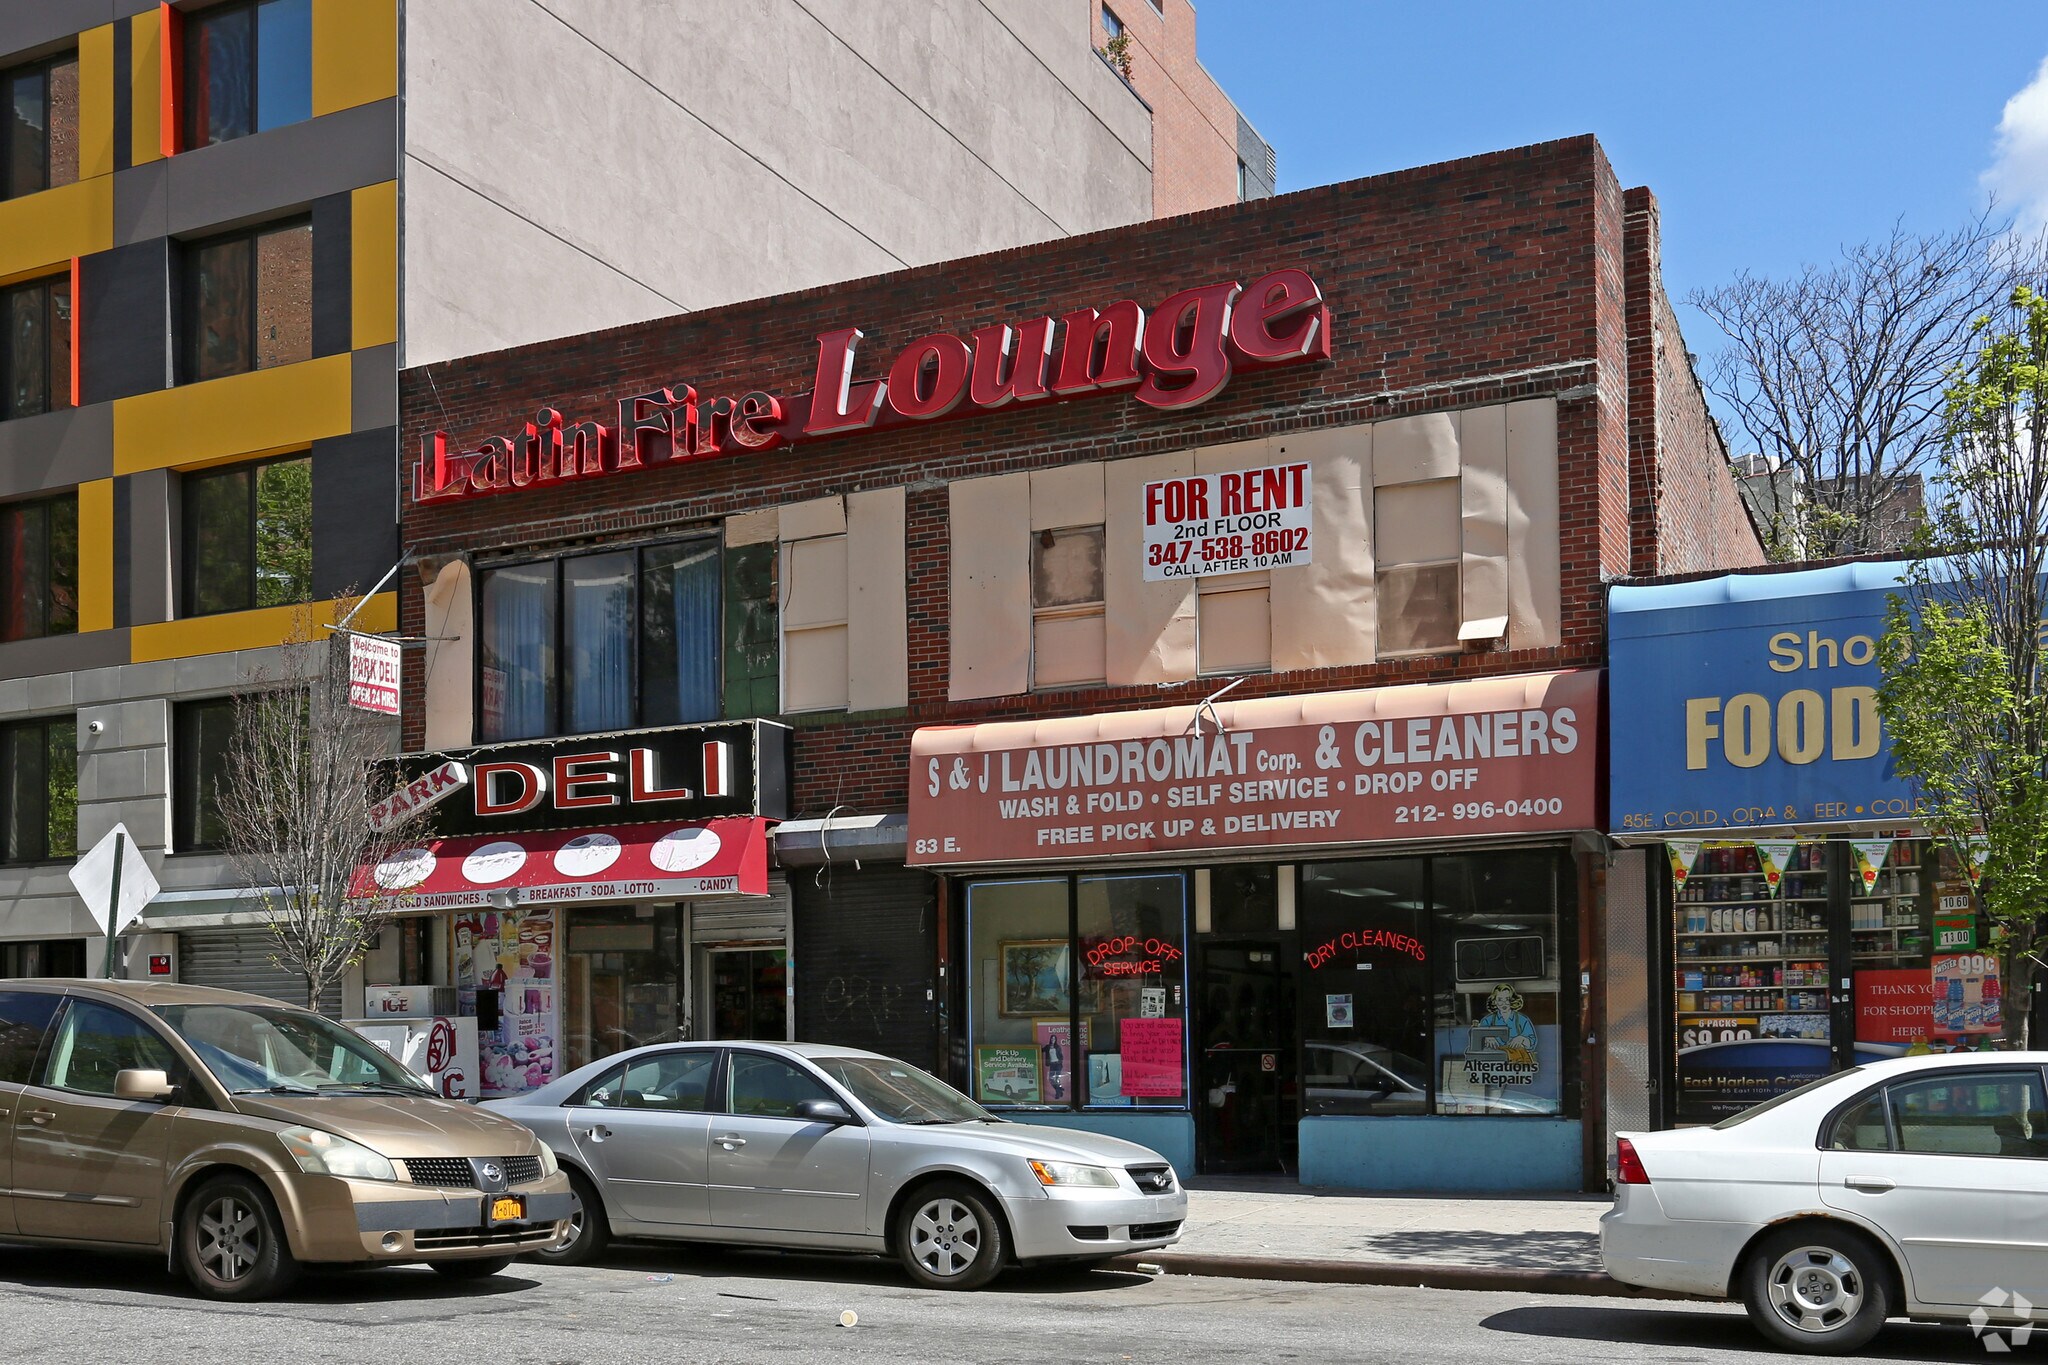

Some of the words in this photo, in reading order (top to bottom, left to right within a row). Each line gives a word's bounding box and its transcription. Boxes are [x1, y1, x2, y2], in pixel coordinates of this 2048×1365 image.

[419, 406, 618, 501] Latin
[617, 382, 782, 469] Fire
[802, 268, 1323, 433] Lounge
[1146, 478, 1209, 526] FOR
[1220, 464, 1308, 517] RENT
[1174, 521, 1208, 540] 2nd
[1215, 512, 1282, 535] FLOOR
[1148, 527, 1308, 567] 347-538-8602
[1163, 563, 1200, 577] CALL
[1203, 558, 1249, 574] AFTER
[1253, 555, 1268, 568] 10
[1271, 552, 1292, 565] AM
[352, 637, 389, 657] Welcome
[391, 646, 398, 658] to
[352, 655, 377, 681] PARK
[379, 660, 398, 684] DELI
[351, 684, 371, 703] OPEN
[371, 688, 381, 704] 24
[1685, 685, 1882, 771] FOOD
[928, 756, 940, 798] S
[949, 756, 971, 791] &
[978, 753, 989, 794] J
[1001, 731, 1254, 793] LAUNDROMAT
[1256, 749, 1302, 775] Corp.
[1314, 724, 1342, 770] &
[1354, 706, 1579, 768] CLEANERS
[369, 762, 458, 829] PARK
[473, 740, 730, 816] DELI
[999, 796, 1059, 820] WASH
[1065, 794, 1081, 816] &
[1087, 789, 1144, 814] FOLD
[1167, 783, 1223, 808] SELF
[1228, 776, 1329, 804] SERVICE
[1354, 771, 1423, 796] DROP
[1430, 767, 1479, 791] OFF
[1395, 803, 1446, 824] 212-
[1452, 797, 1564, 820] 996-0400
[1664, 809, 1718, 827] COLD
[1783, 804, 1798, 820] &
[1037, 825, 1095, 846] FREE
[1101, 820, 1156, 842] PICK
[1163, 818, 1195, 838] UP
[1200, 817, 1217, 836] &
[1224, 809, 1341, 834] DELIVERY
[915, 838, 938, 855] 83
[944, 837, 961, 853] E.
[423, 892, 480, 907] SANDWICHES
[529, 886, 582, 901] BREAKFAST
[591, 884, 615, 896] SODA
[624, 882, 654, 894] LOTTO
[700, 877, 733, 891] CANDY
[1087, 936, 1183, 966] DROP-OFF
[1307, 939, 1336, 969] DRY
[1340, 929, 1426, 961] CLEANERS
[1459, 940, 1541, 977] OPEN
[1103, 960, 1161, 975] SERVICE
[1870, 984, 1915, 995] THANK
[1918, 984, 1933, 994] YO
[382, 996, 409, 1012] ICE
[1863, 1006, 1886, 1016] FOR
[1892, 1005, 1934, 1016] SHOPPI
[1707, 1019, 1738, 1027] PACKS
[1892, 1027, 1925, 1036] HERE
[1463, 1060, 1539, 1074] Alterations
[1469, 1073, 1481, 1084] &
[1482, 1073, 1532, 1087] Repairs
[1683, 1077, 1713, 1088] East
[1717, 1076, 1769, 1088] Harlem
